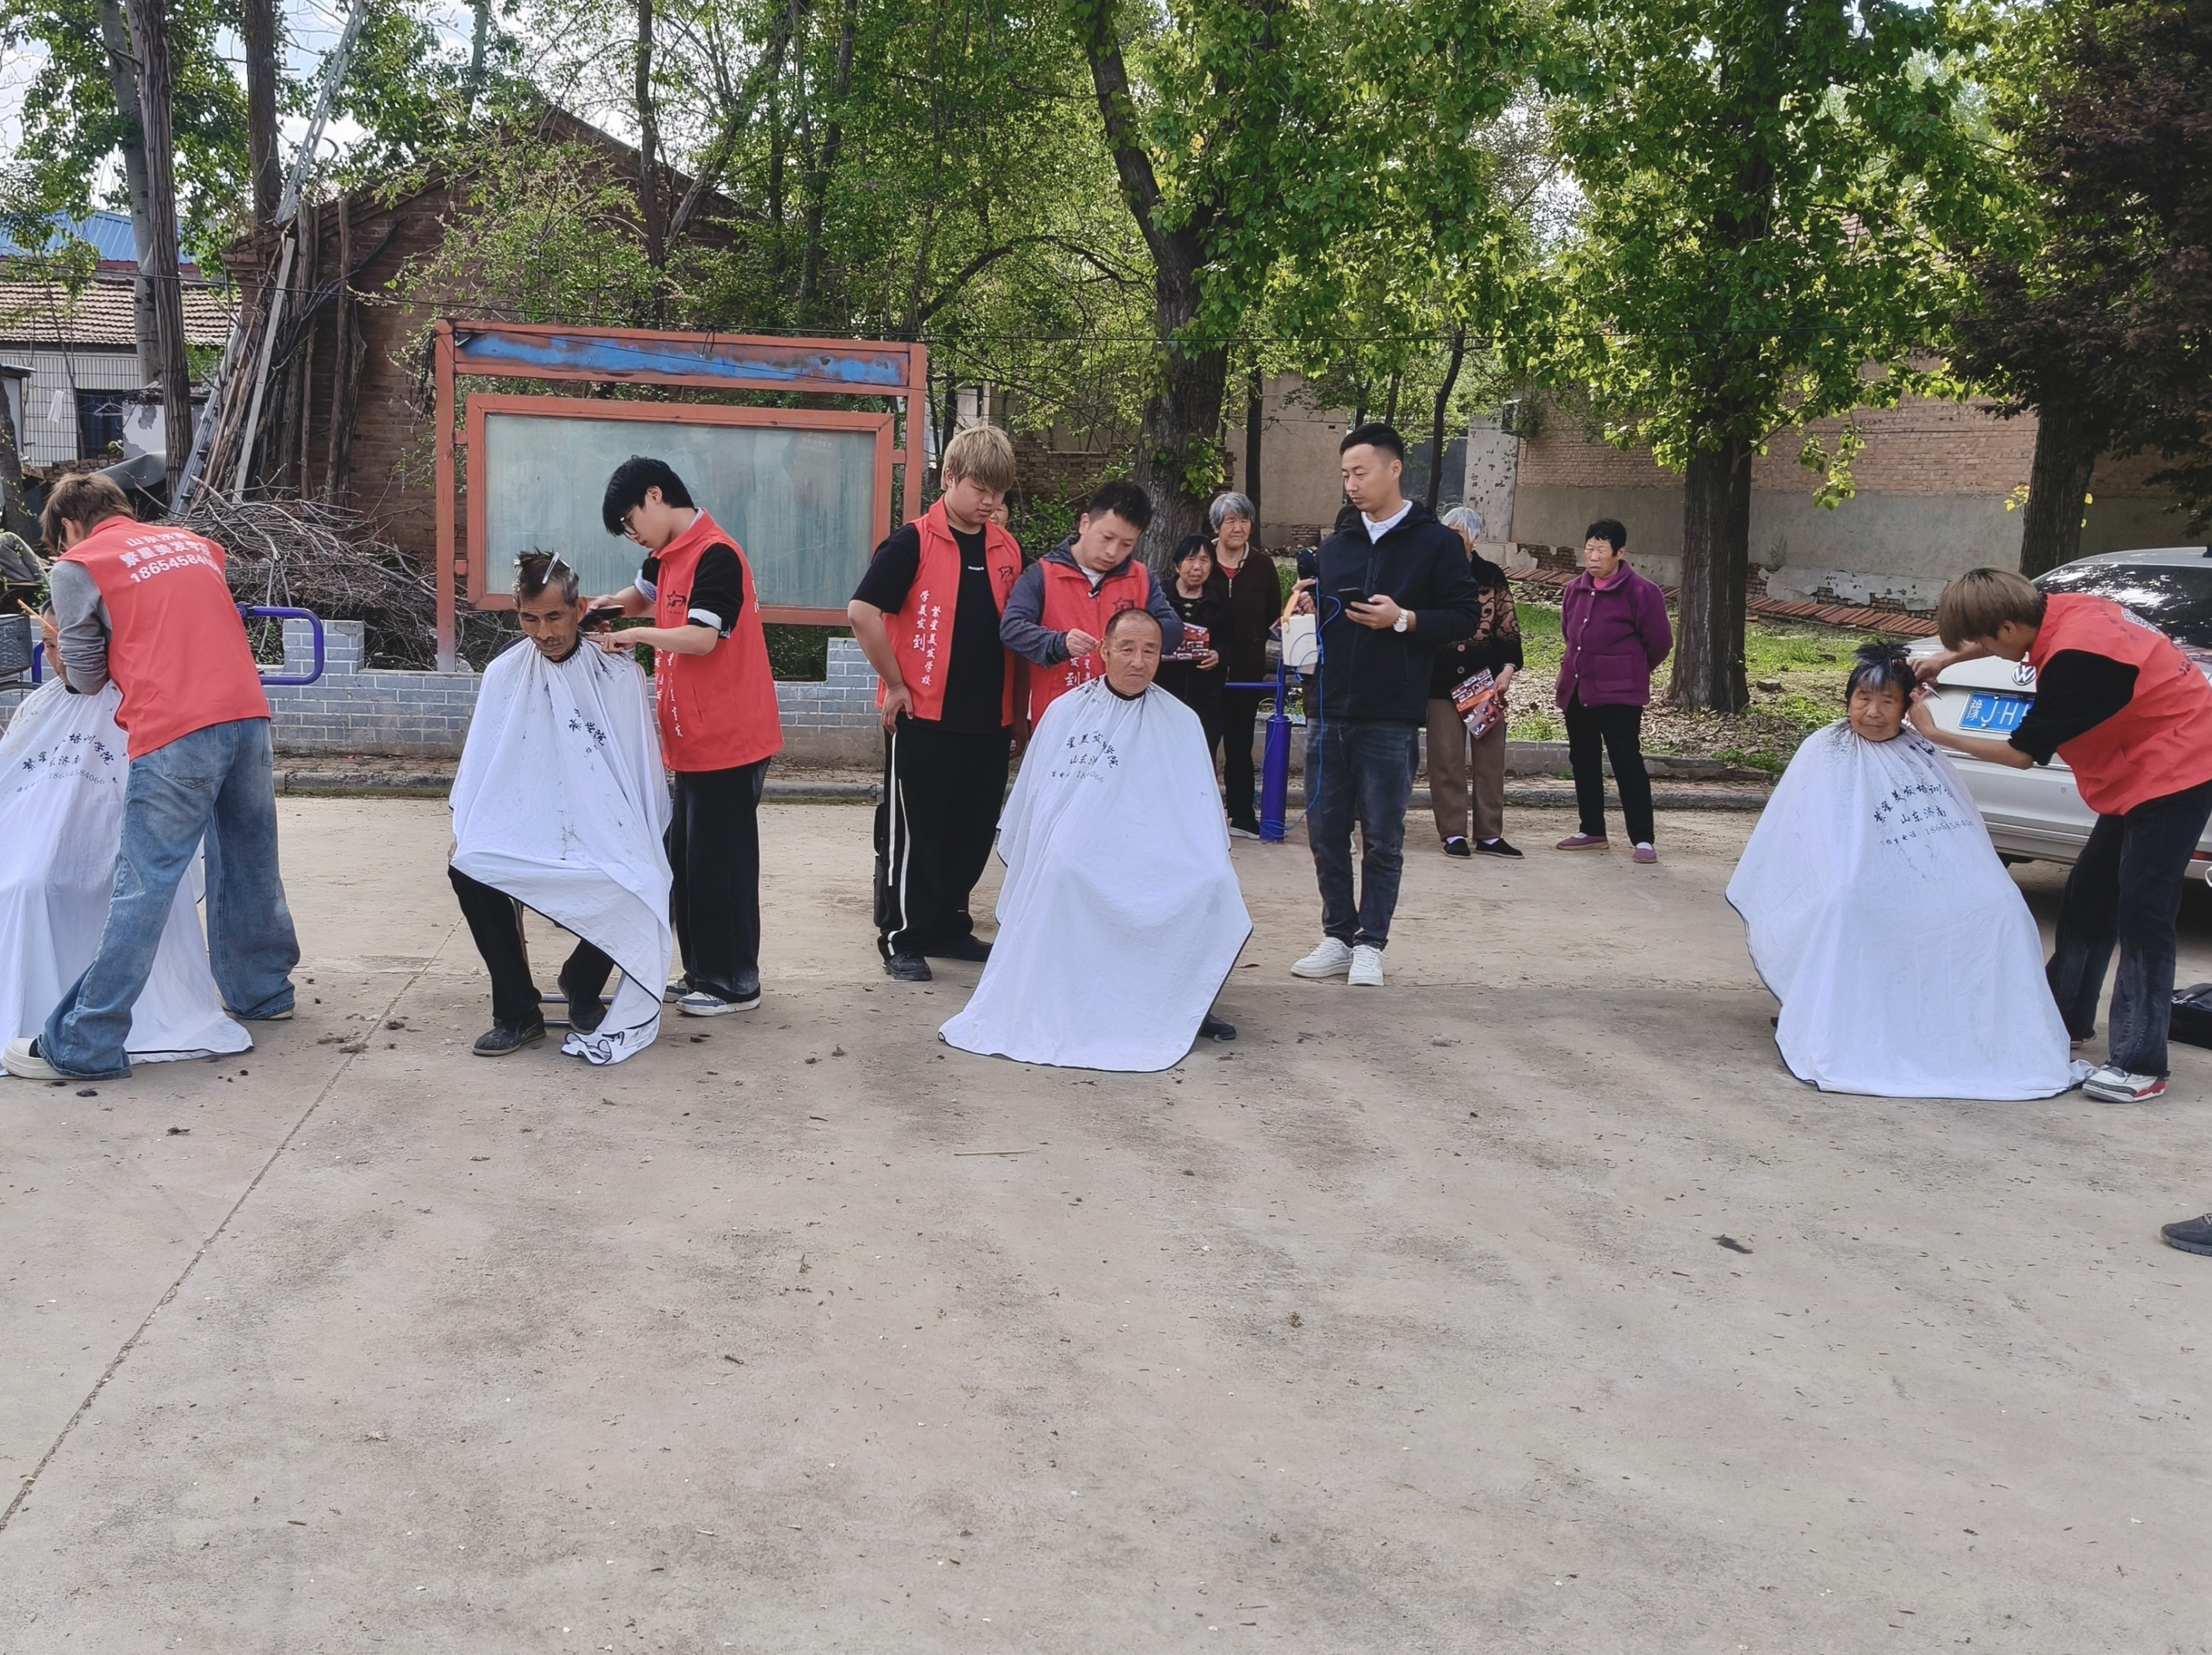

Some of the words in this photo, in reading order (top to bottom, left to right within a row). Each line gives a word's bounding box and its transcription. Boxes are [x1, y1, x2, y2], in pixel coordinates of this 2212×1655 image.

[913, 590, 929, 651] 学美发到
[921, 606, 941, 686] 繁星美发学校
